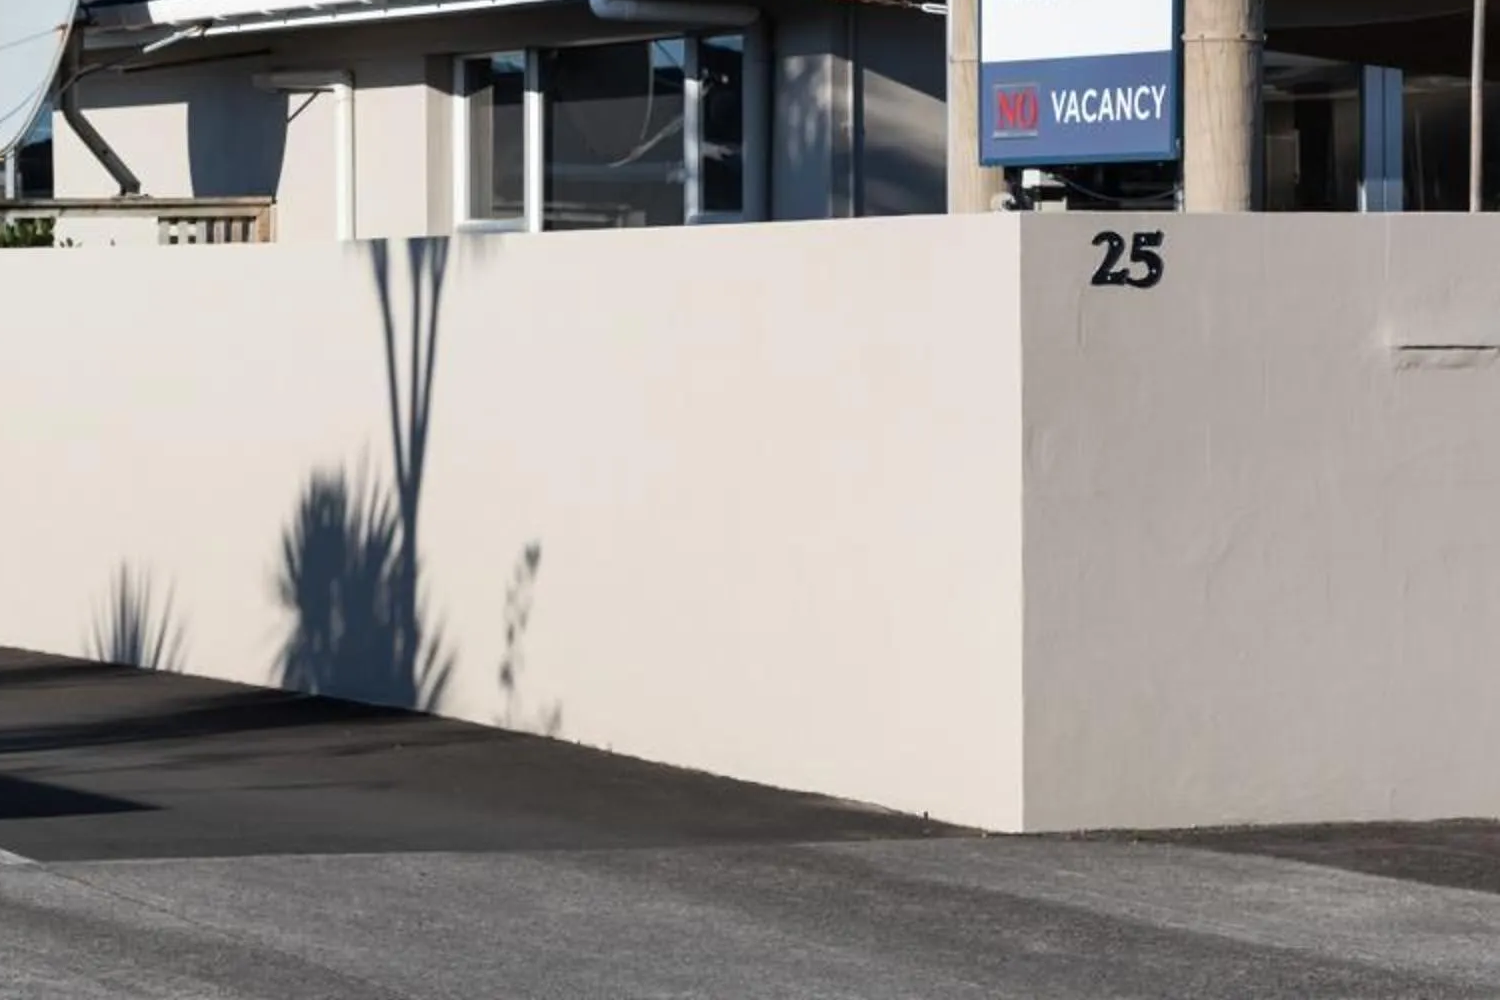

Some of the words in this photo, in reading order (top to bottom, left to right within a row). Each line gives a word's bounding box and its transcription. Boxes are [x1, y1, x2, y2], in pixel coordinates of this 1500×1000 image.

[997, 86, 1039, 131] NO
[1051, 84, 1167, 124] VACANCY
[1091, 229, 1165, 289] 25
